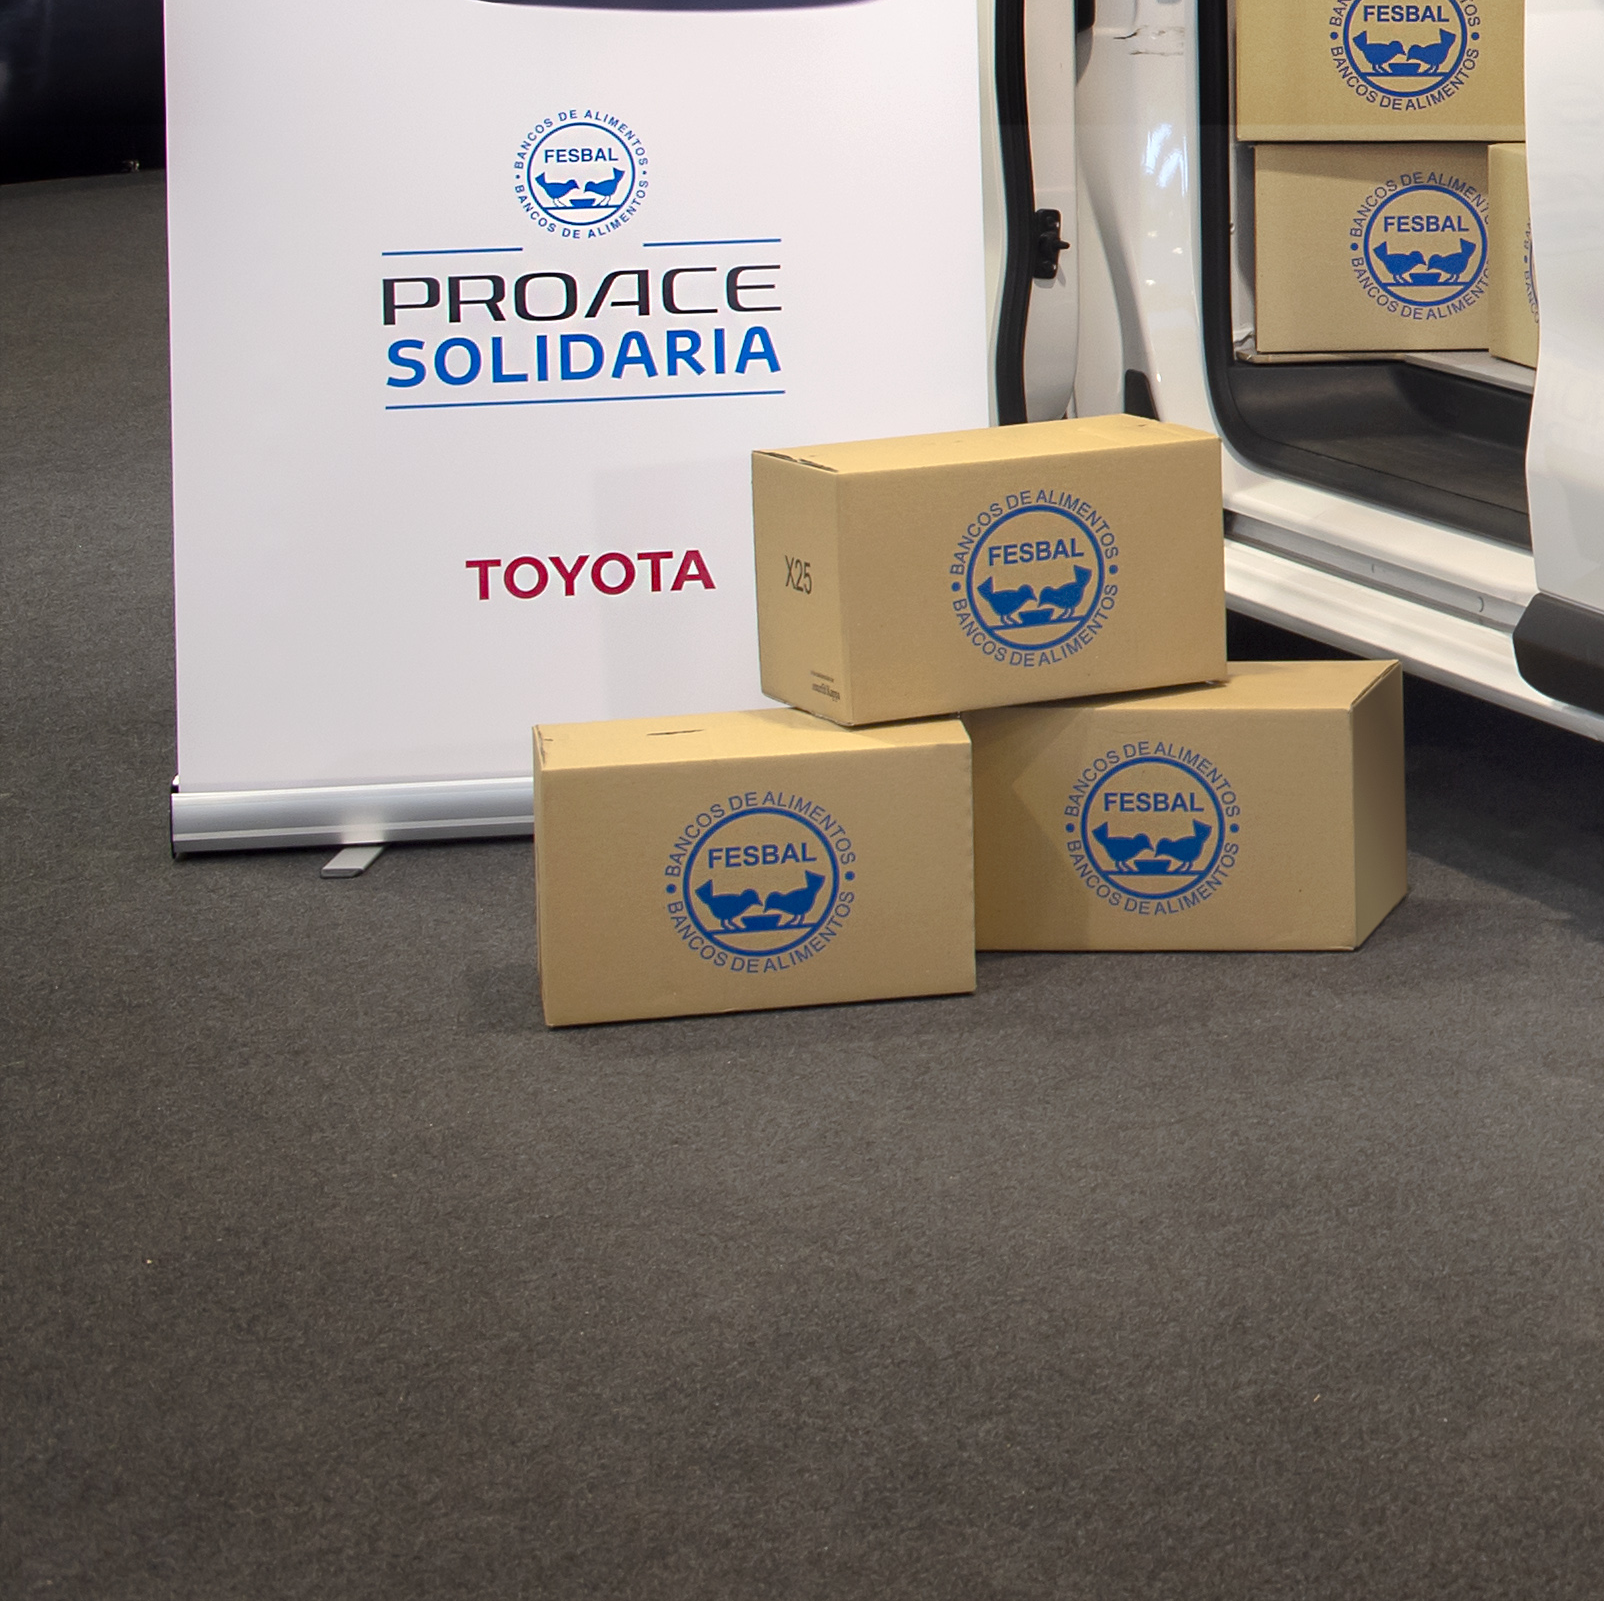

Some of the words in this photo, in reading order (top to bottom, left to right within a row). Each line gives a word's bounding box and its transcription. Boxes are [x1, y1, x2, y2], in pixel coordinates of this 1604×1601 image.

[1363, 5, 1449, 22] FESBAL
[1330, 46, 1378, 103] BANCOS
[1379, 96, 1402, 111] DE
[1405, 48, 1479, 111] ALIMENTOS
[514, 118, 553, 169] BANCOS
[558, 110, 578, 122] DE
[584, 110, 648, 166] ALIMENTOS
[544, 148, 619, 163] FESBAL
[515, 184, 556, 232] BANCOS
[562, 227, 580, 238] DE
[588, 180, 649, 238] ALIMENTOS
[1349, 179, 1397, 237] BANCOS
[1400, 171, 1423, 186] DE
[1383, 215, 1470, 233] FESBAL
[382, 264, 783, 326] PROACE
[1351, 256, 1399, 313] BANCOS
[1400, 306, 1423, 320] DE
[385, 326, 782, 388] SOLIDARIA
[950, 502, 1003, 575] BANCOS
[1005, 490, 1032, 510] DE
[1035, 489, 1119, 560] ALIMENTOS
[988, 537, 1085, 566] FESBAL
[465, 549, 717, 602] TOYOTA
[784, 554, 813, 595] X25
[952, 598, 1007, 662] BANCOS
[1009, 650, 1035, 667] DE
[1038, 584, 1118, 667] ALIMENTOS
[1064, 750, 1120, 818] BANCOS
[1123, 741, 1151, 759] DE
[1154, 741, 1241, 818] ALIMENTOS
[1103, 792, 1205, 813] FESBAL
[664, 803, 725, 877] BANCOS
[728, 791, 758, 811] DE
[762, 791, 856, 865] ALIMENTOS
[708, 842, 818, 869] FESBAL
[1066, 839, 1122, 906] BANCOS
[1124, 897, 1151, 915] DE
[1154, 841, 1239, 915] ALIMENTOS
[667, 900, 729, 967] BANCOS
[730, 956, 759, 973] DE
[763, 890, 855, 973] ALIMENTOS
